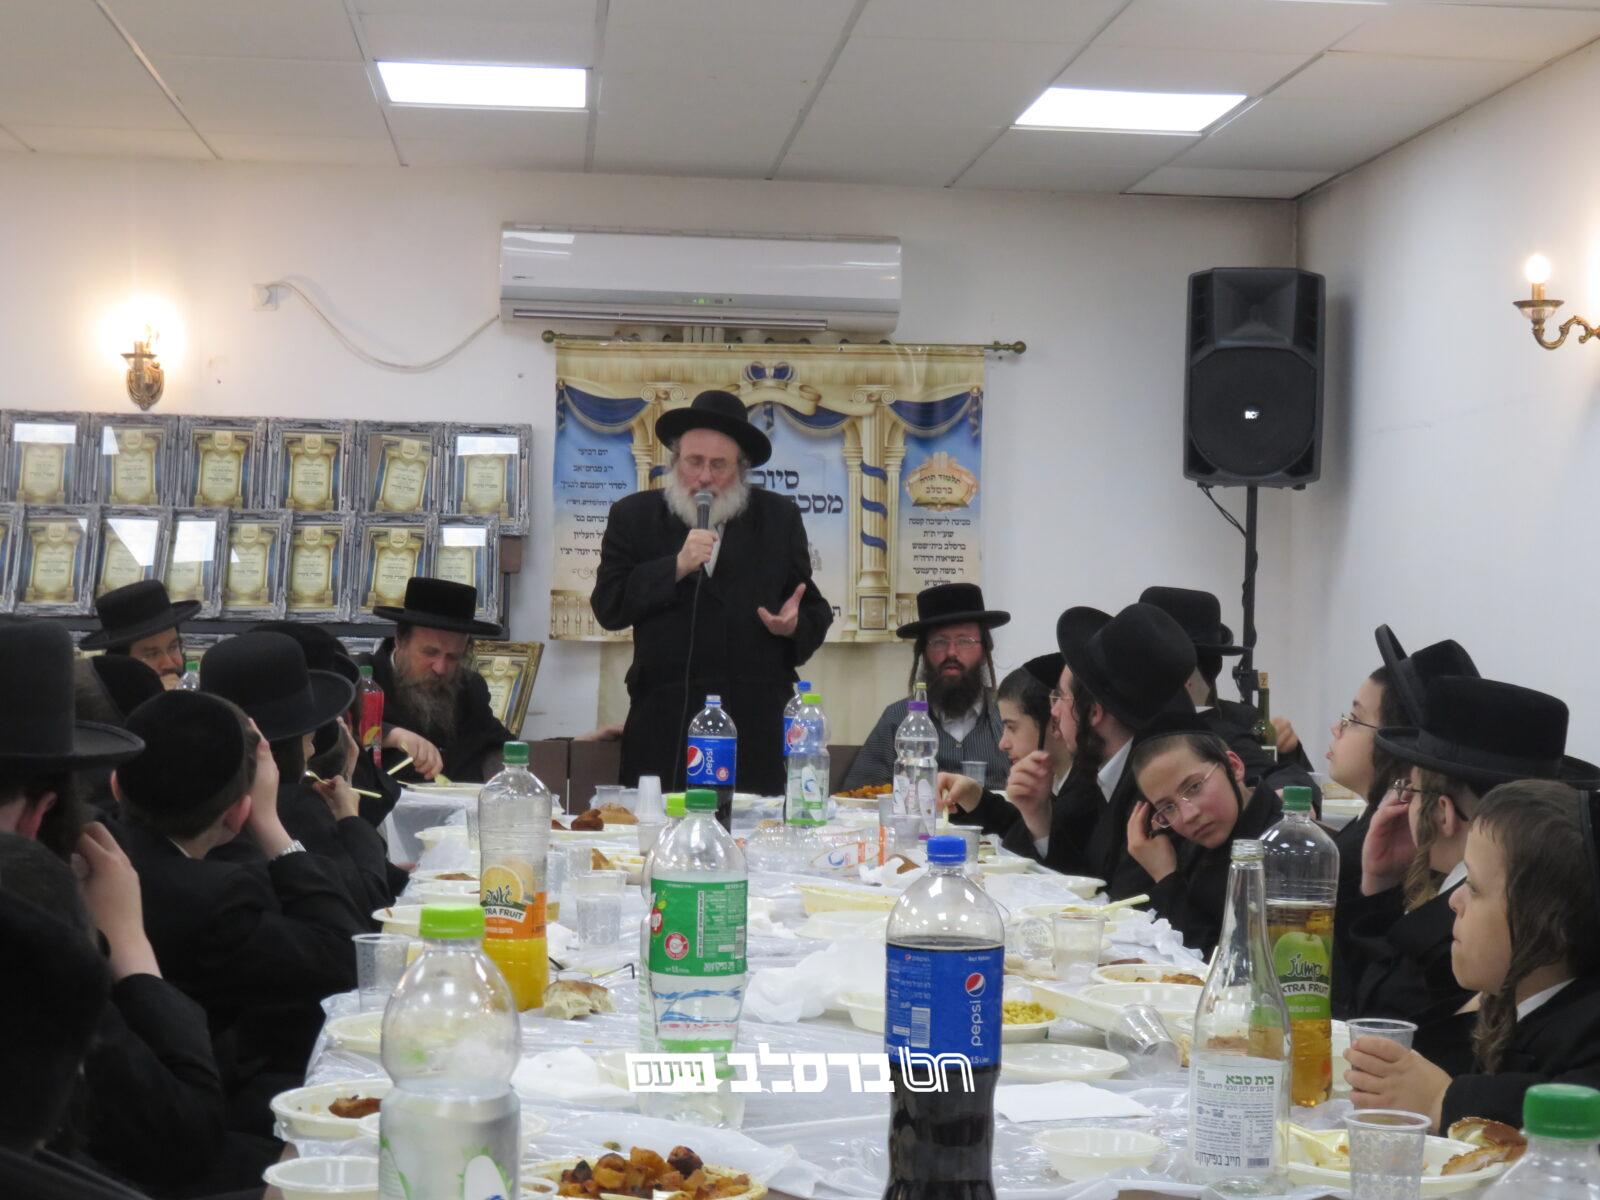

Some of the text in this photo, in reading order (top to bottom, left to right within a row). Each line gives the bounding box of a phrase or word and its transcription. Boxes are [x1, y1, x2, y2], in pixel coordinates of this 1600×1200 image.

[926, 485, 952, 494] ברסלב
[790, 494, 844, 514] מסכ
[944, 541, 966, 550] ברסלב
[705, 747, 715, 776] pepsi
[485, 907, 524, 920] TRA FRUIT
[1287, 954, 1322, 982] Jump
[969, 999, 984, 1047] pepsi
[1225, 1073, 1275, 1085] בית סבא
